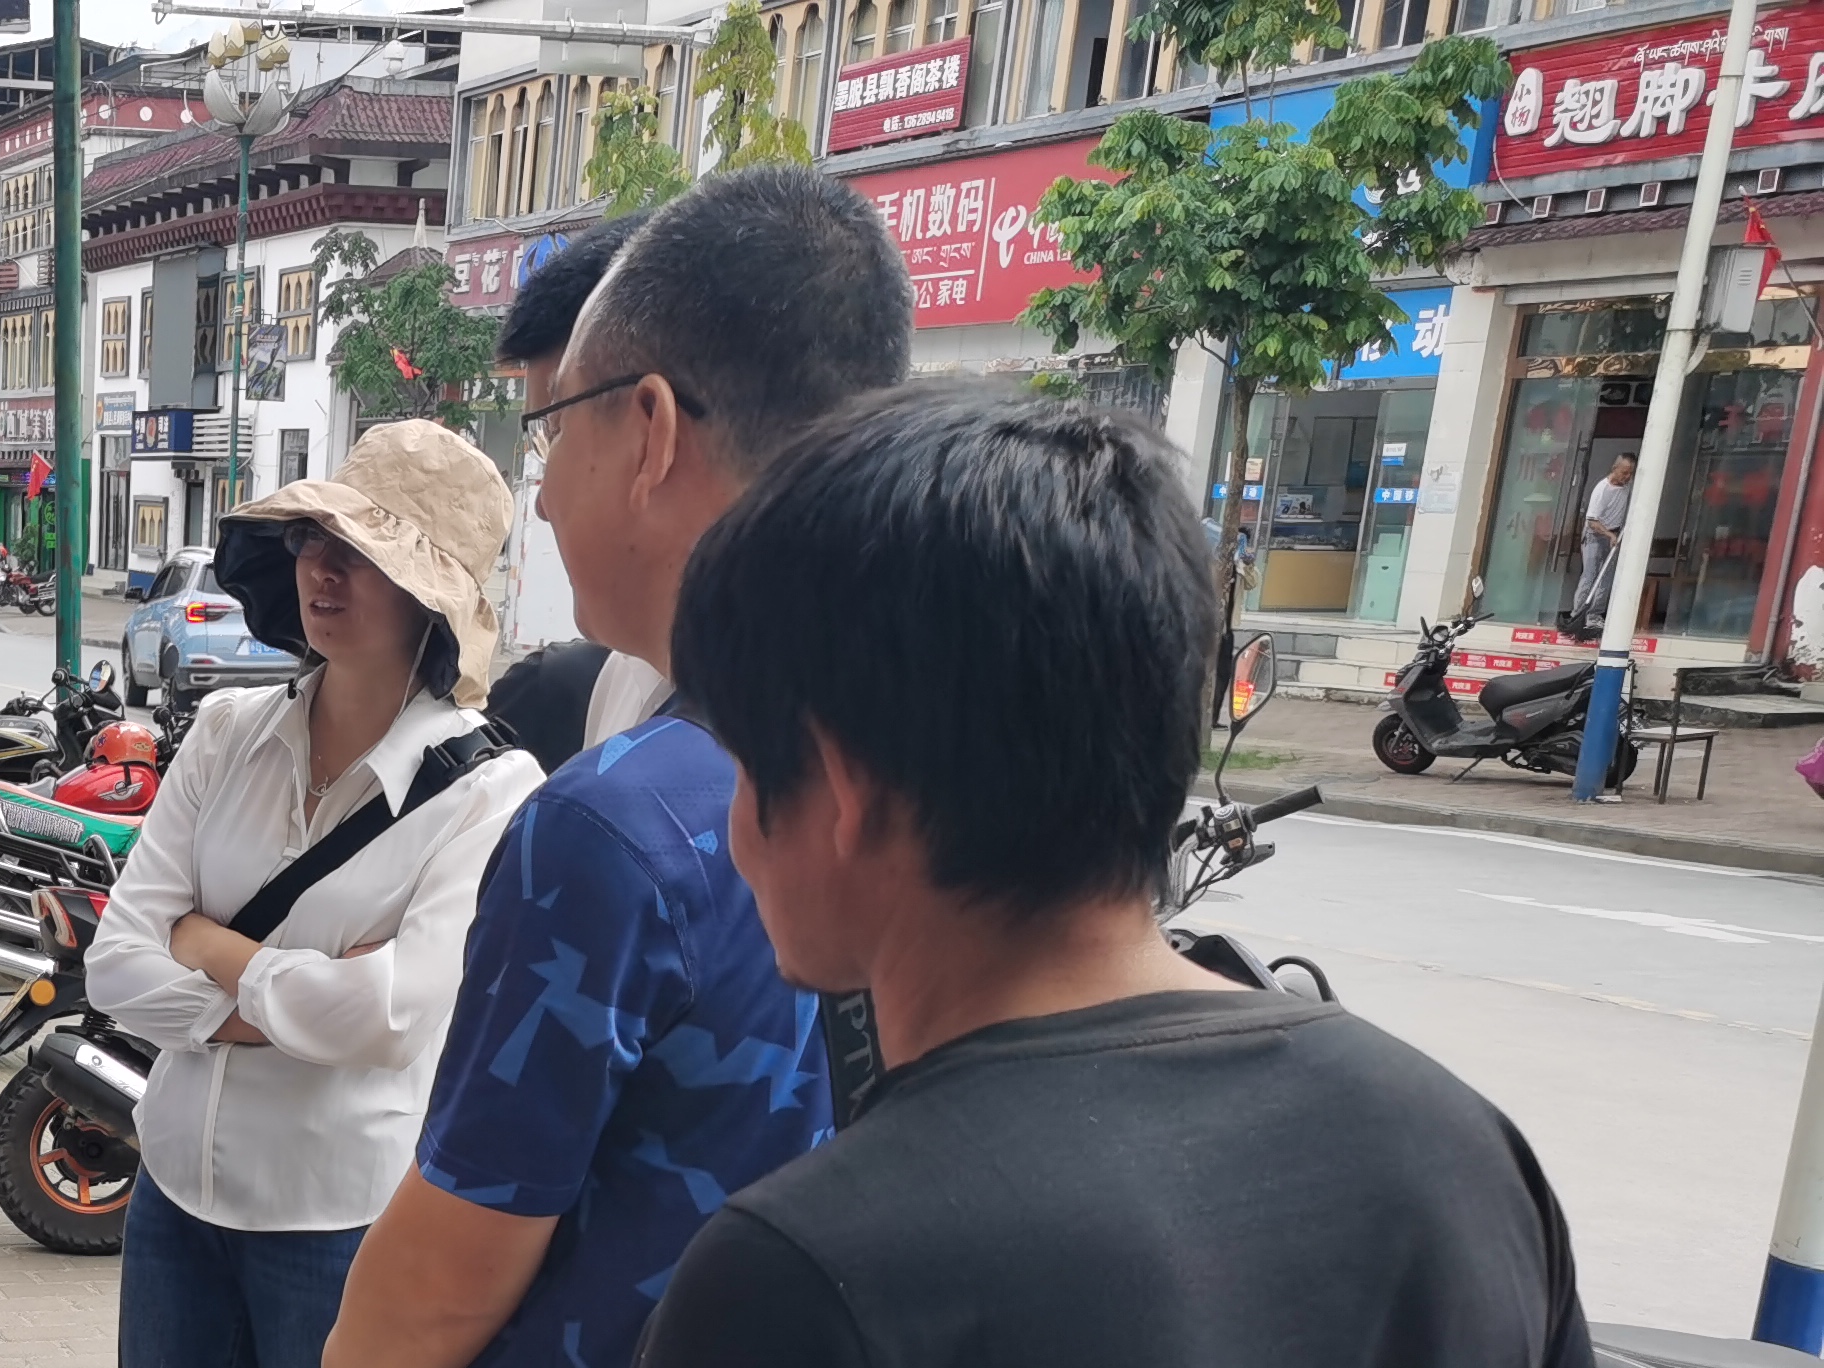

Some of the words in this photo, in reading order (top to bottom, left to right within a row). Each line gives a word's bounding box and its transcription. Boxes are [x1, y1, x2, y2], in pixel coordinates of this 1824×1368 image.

[834, 54, 962, 111] 墨脱县飘香阁茶楼
[1024, 249, 1054, 265] CHINA
